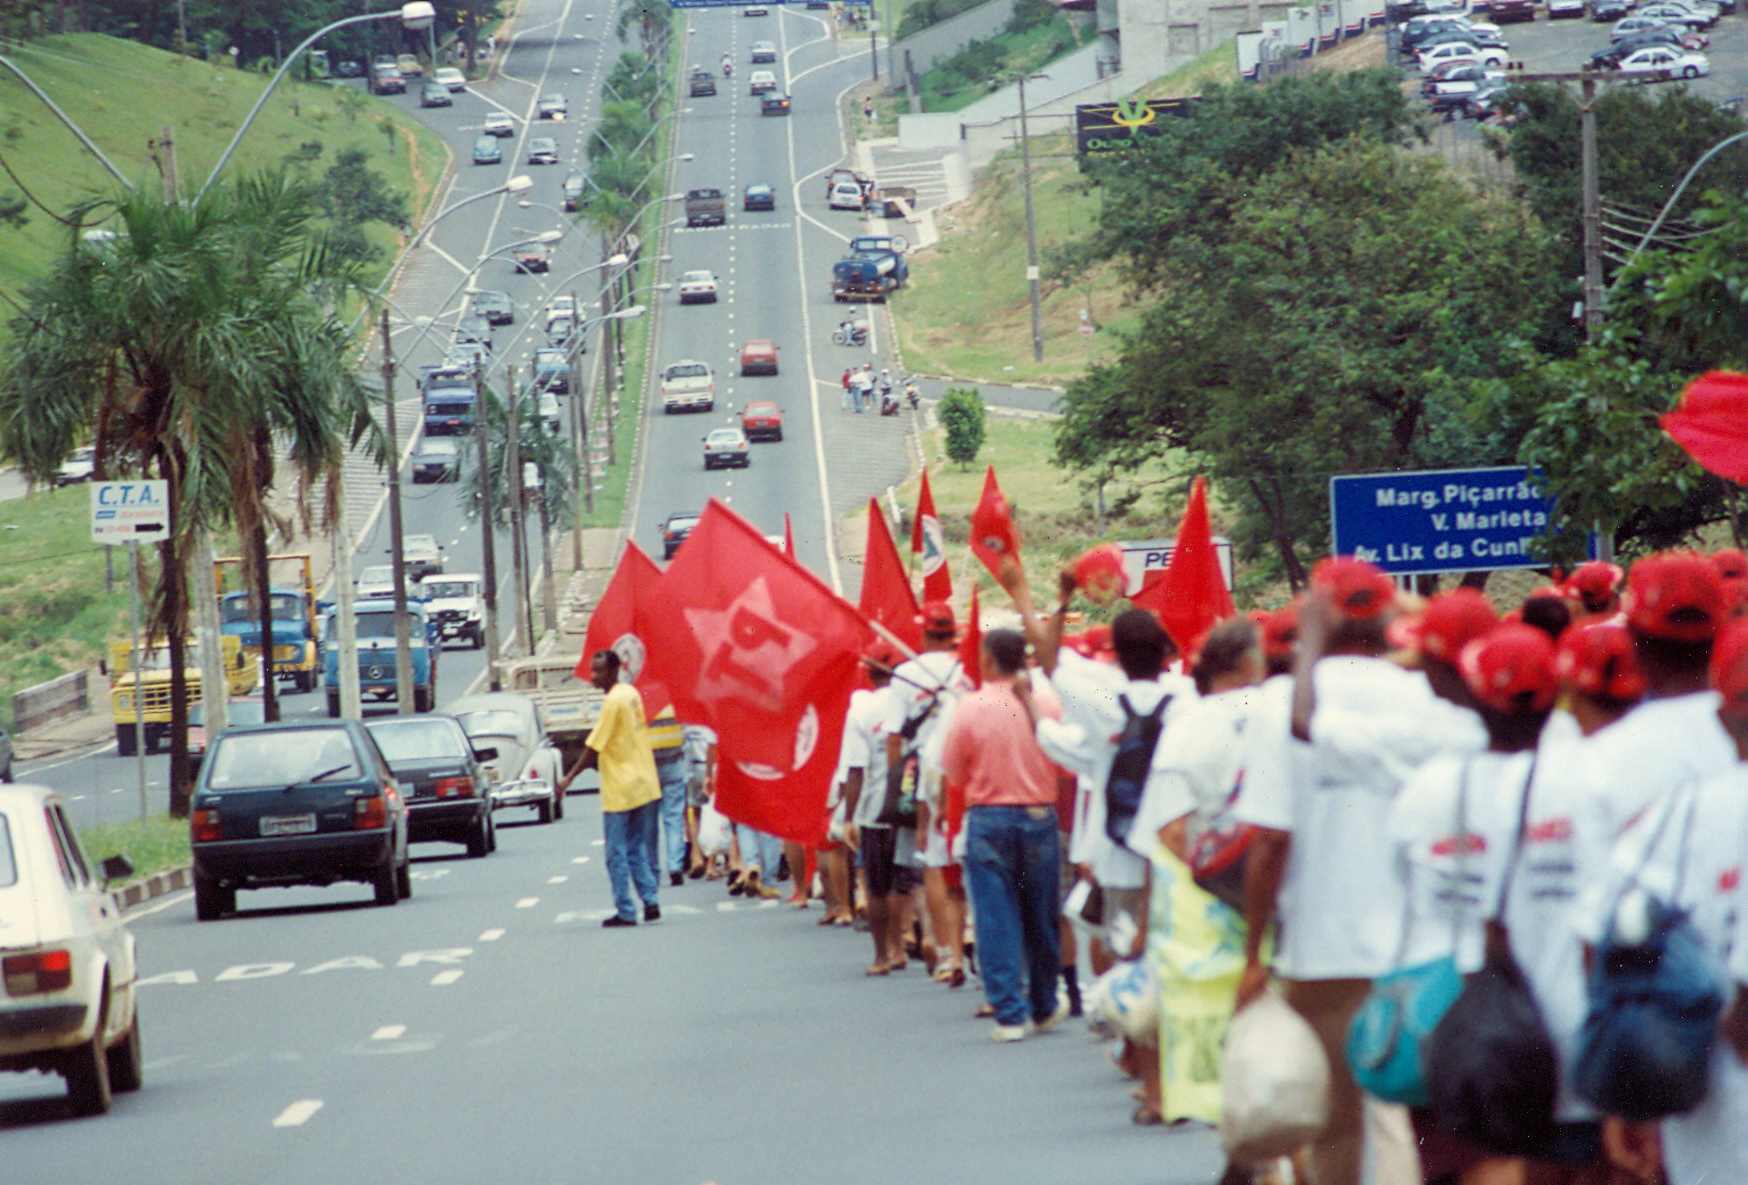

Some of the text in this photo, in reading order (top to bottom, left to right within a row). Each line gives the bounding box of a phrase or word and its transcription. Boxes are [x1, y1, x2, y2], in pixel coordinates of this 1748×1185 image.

[98, 484, 160, 505] C.T.A.
[1431, 510, 1547, 531] V. Marieta
[1145, 552, 1175, 567] PE
[1387, 543, 1424, 562] Lix
[1434, 539, 1464, 559] da
